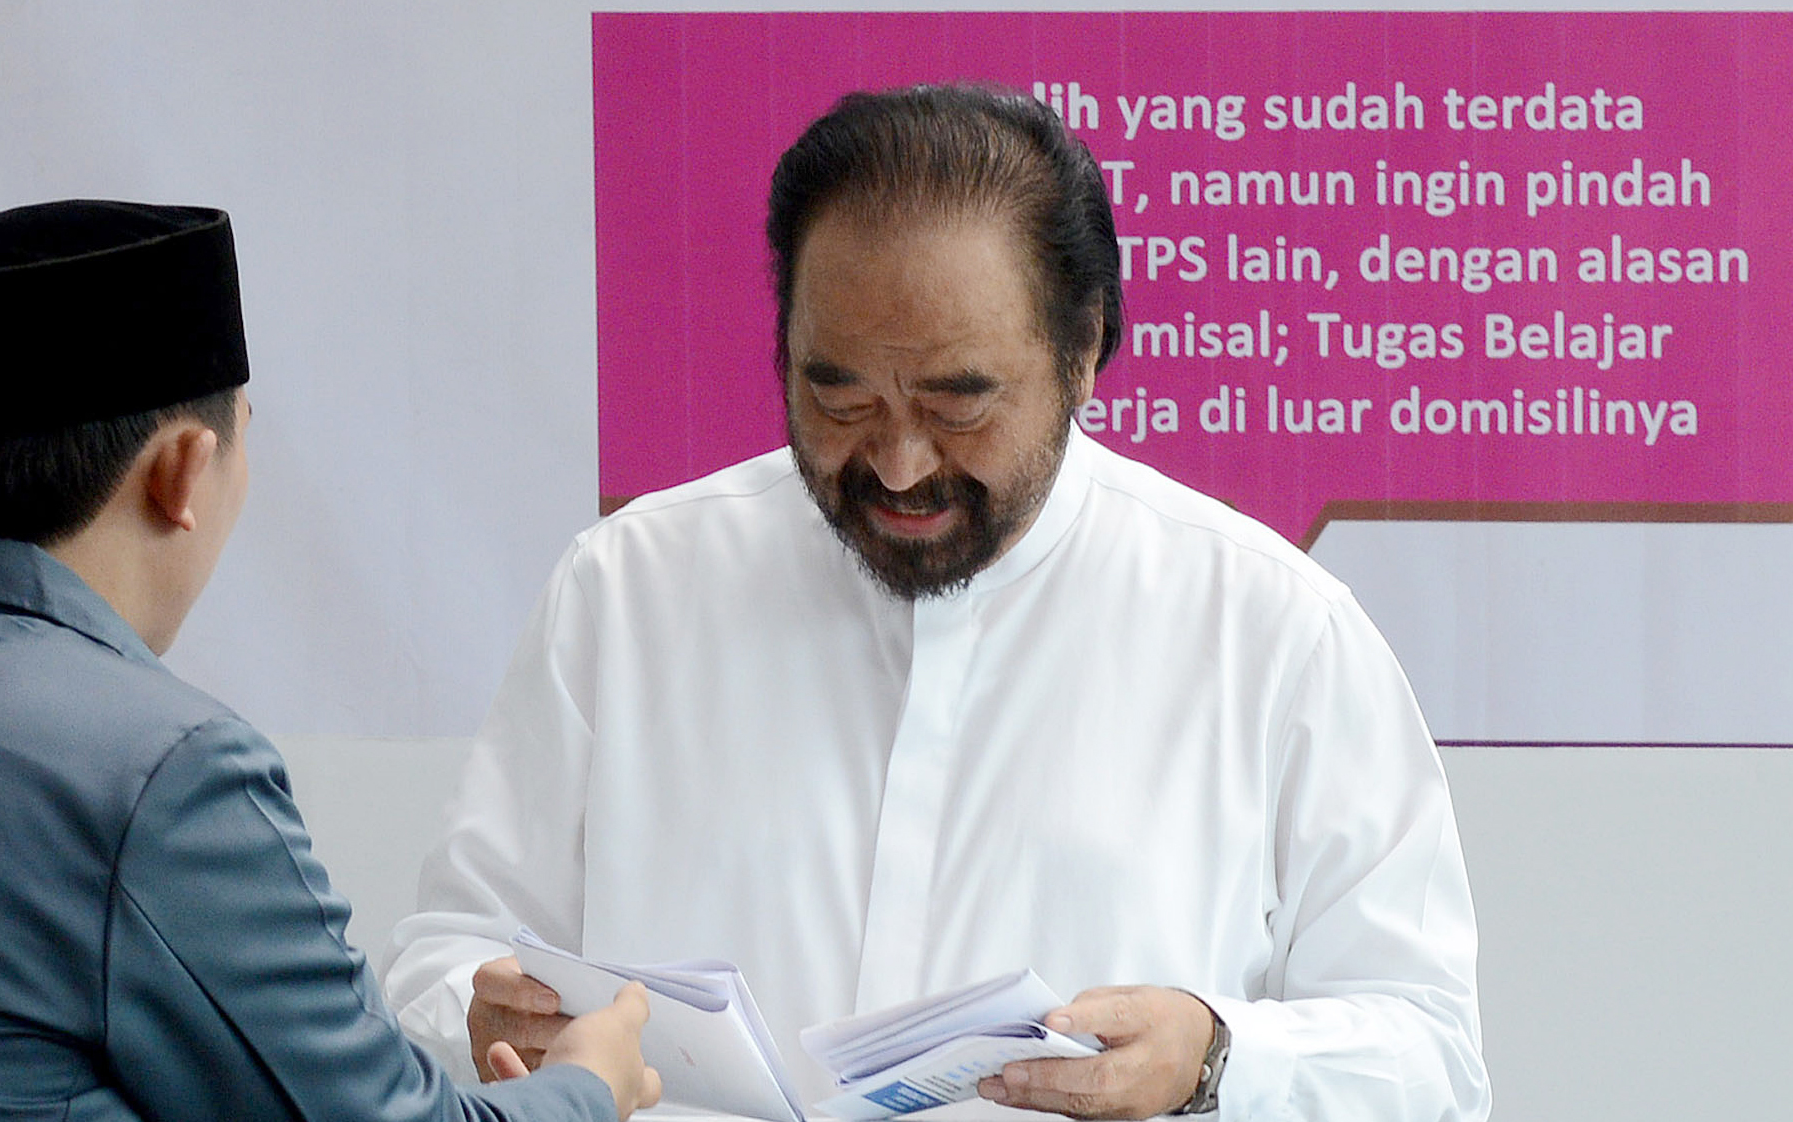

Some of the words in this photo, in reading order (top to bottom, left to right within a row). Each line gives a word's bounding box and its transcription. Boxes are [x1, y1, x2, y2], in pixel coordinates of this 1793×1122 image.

[1117, 95, 1246, 141] yang
[1264, 82, 1424, 130] sudah
[1443, 82, 1643, 131] terdata
[1101, 161, 1148, 213] T,
[1171, 171, 1354, 205] namun
[1377, 160, 1505, 217] ingin
[1527, 158, 1710, 217] pindah
[1116, 236, 1207, 282] TPS
[1228, 234, 1339, 290] lain,
[1359, 234, 1557, 293] dengan
[1578, 234, 1749, 283] alasan
[1133, 309, 1288, 366] misal;
[1307, 313, 1464, 369] Tugas
[1486, 311, 1673, 370] Belajar
[1078, 387, 1178, 442] erja
[1199, 385, 1245, 433] di
[1268, 385, 1372, 433] luar
[1390, 386, 1697, 445] domisilinya
